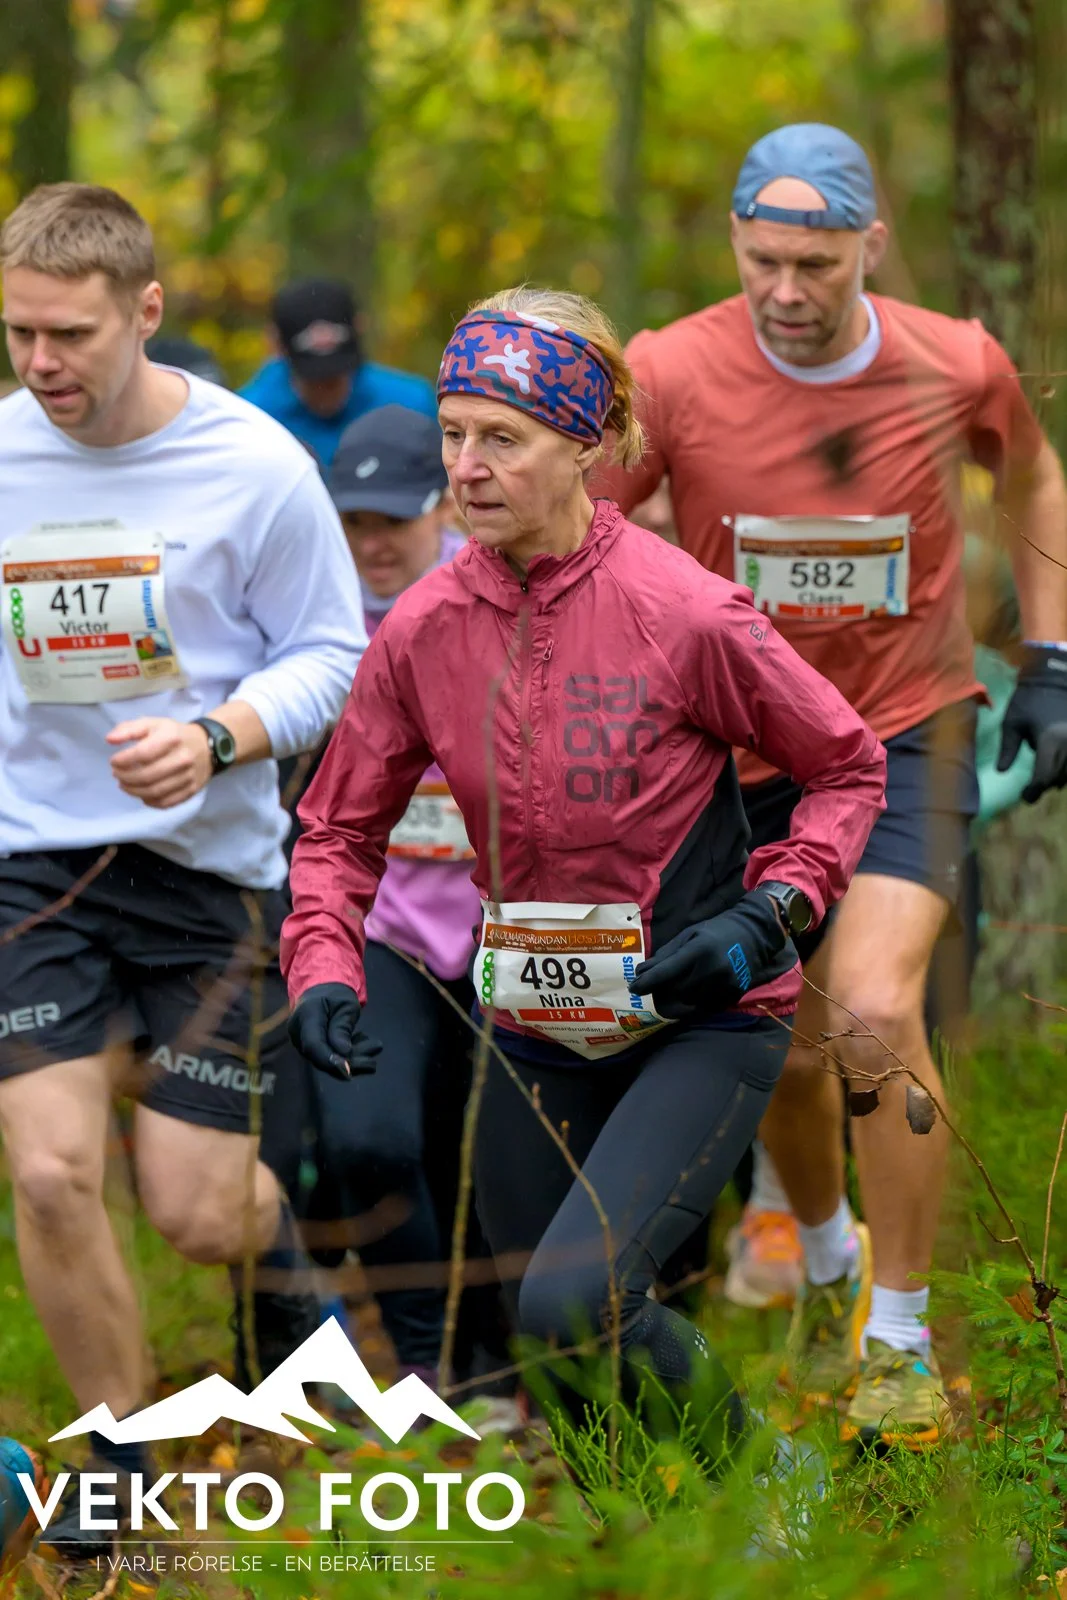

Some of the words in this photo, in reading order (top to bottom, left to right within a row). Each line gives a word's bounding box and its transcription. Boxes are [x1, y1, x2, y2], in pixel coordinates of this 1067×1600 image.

[790, 560, 855, 588] 582
[51, 583, 110, 616] 417
[60, 621, 109, 635] Victor
[520, 956, 592, 990] 498
[538, 993, 585, 1009] Nina
